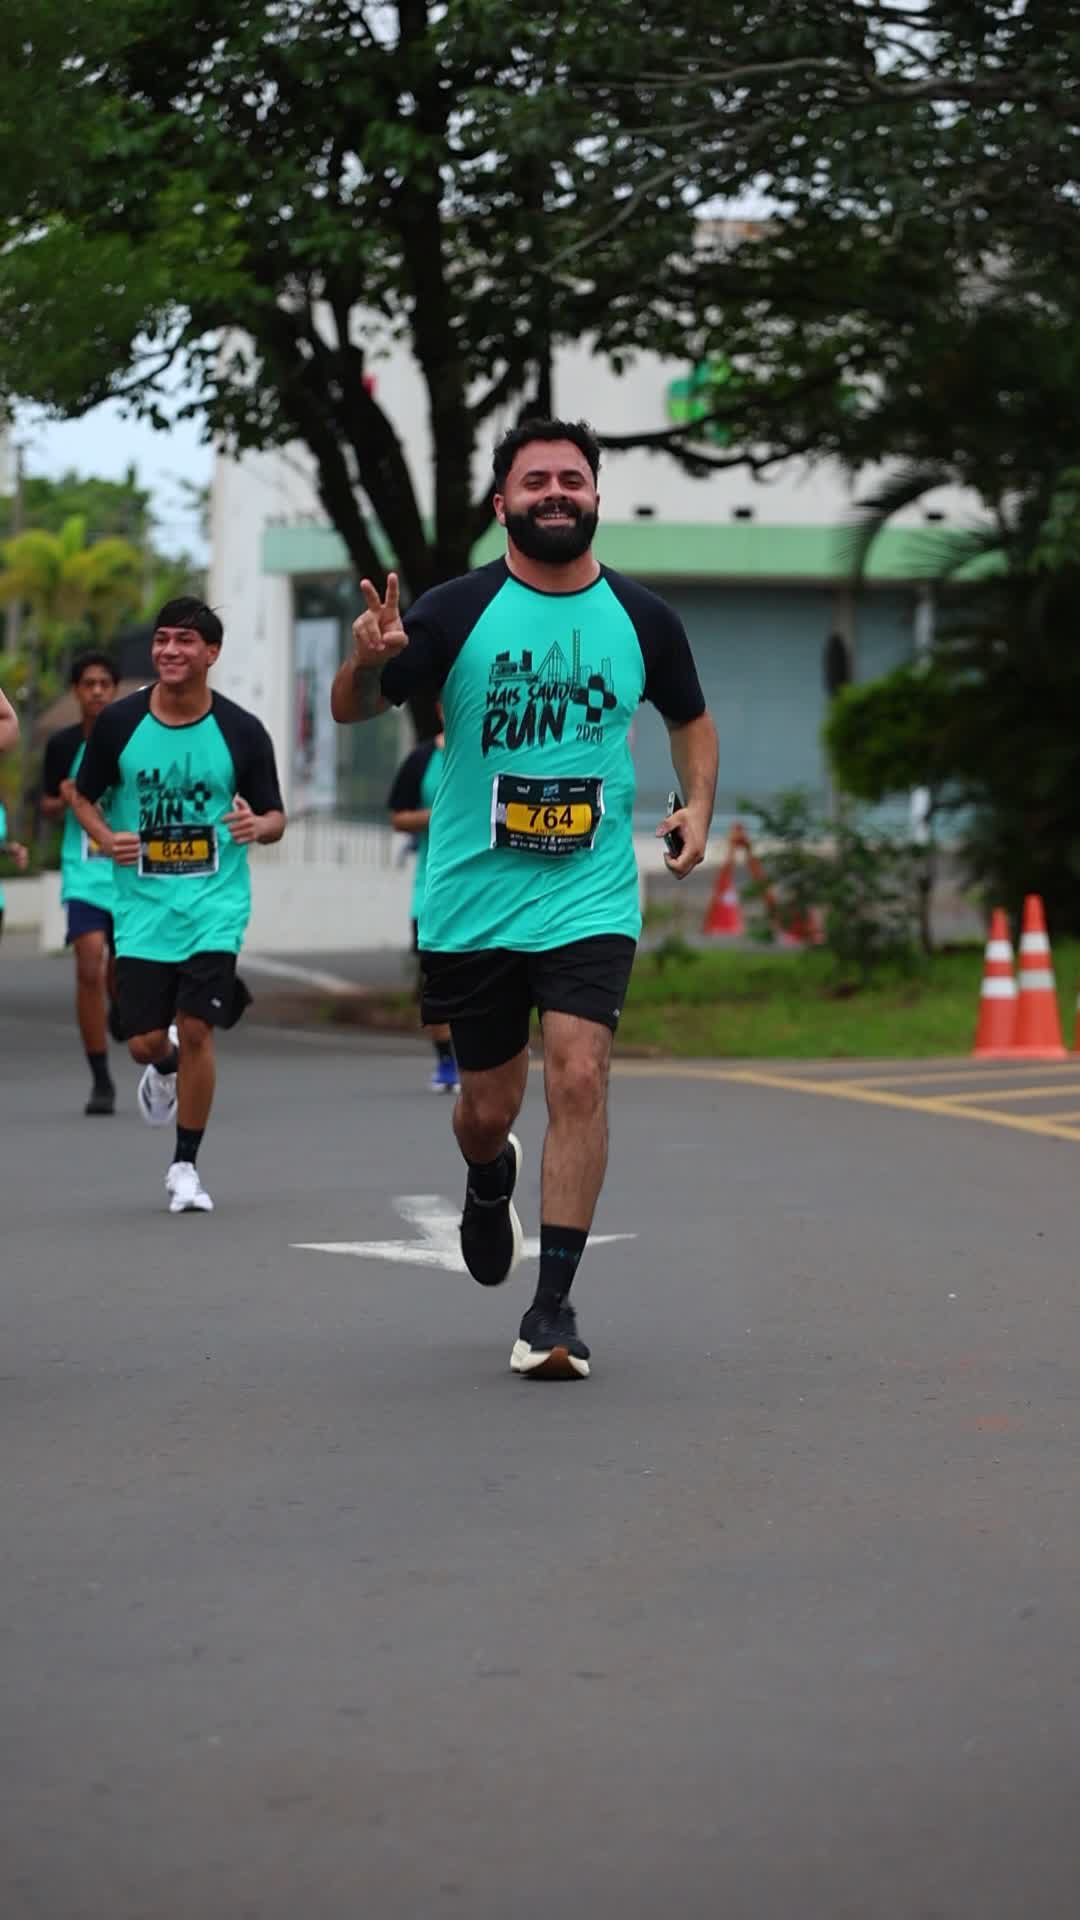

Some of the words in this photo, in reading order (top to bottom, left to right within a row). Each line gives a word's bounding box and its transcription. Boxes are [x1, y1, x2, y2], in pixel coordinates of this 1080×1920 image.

[486, 687, 520, 709] MAIS
[481, 700, 569, 759] RUN
[528, 806, 573, 829] 764
